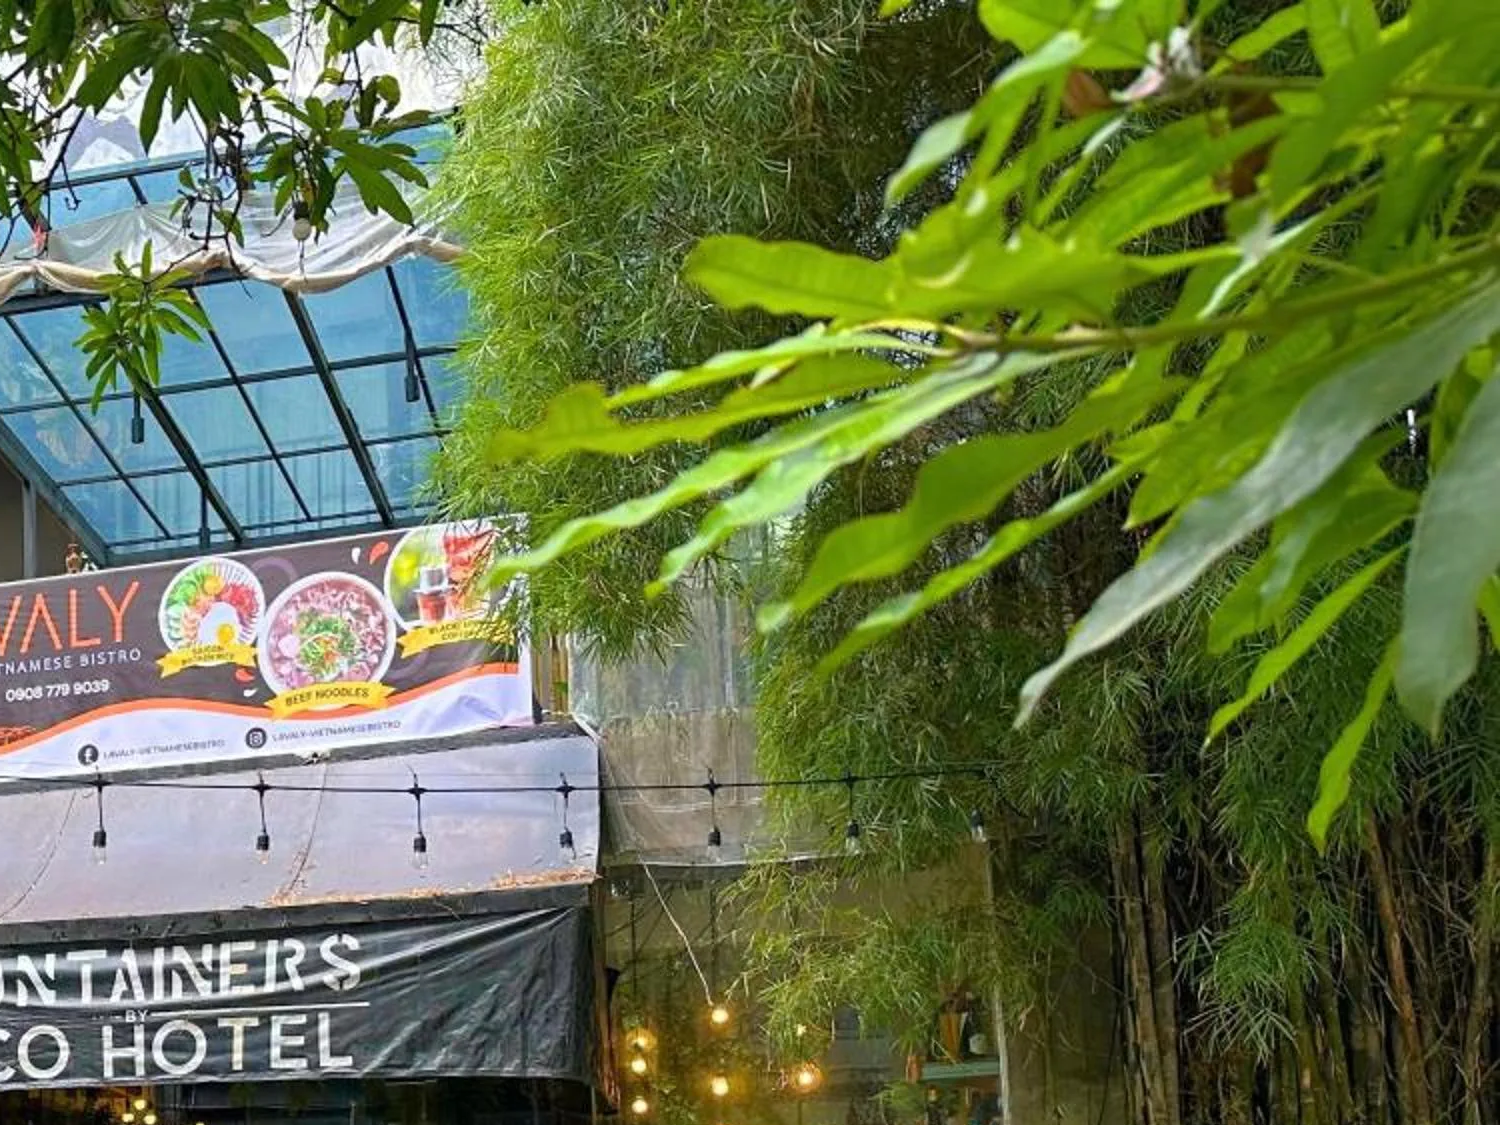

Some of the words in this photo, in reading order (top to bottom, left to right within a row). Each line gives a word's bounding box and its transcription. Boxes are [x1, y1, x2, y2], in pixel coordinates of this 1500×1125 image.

[80, 648, 141, 668] BISTRO
[74, 679, 110, 696] 9039
[285, 691, 312, 707] BEEF
[315, 687, 370, 702] NOODLES
[125, 1010, 148, 1023] BY
[102, 1012, 354, 1078] HOTEL
